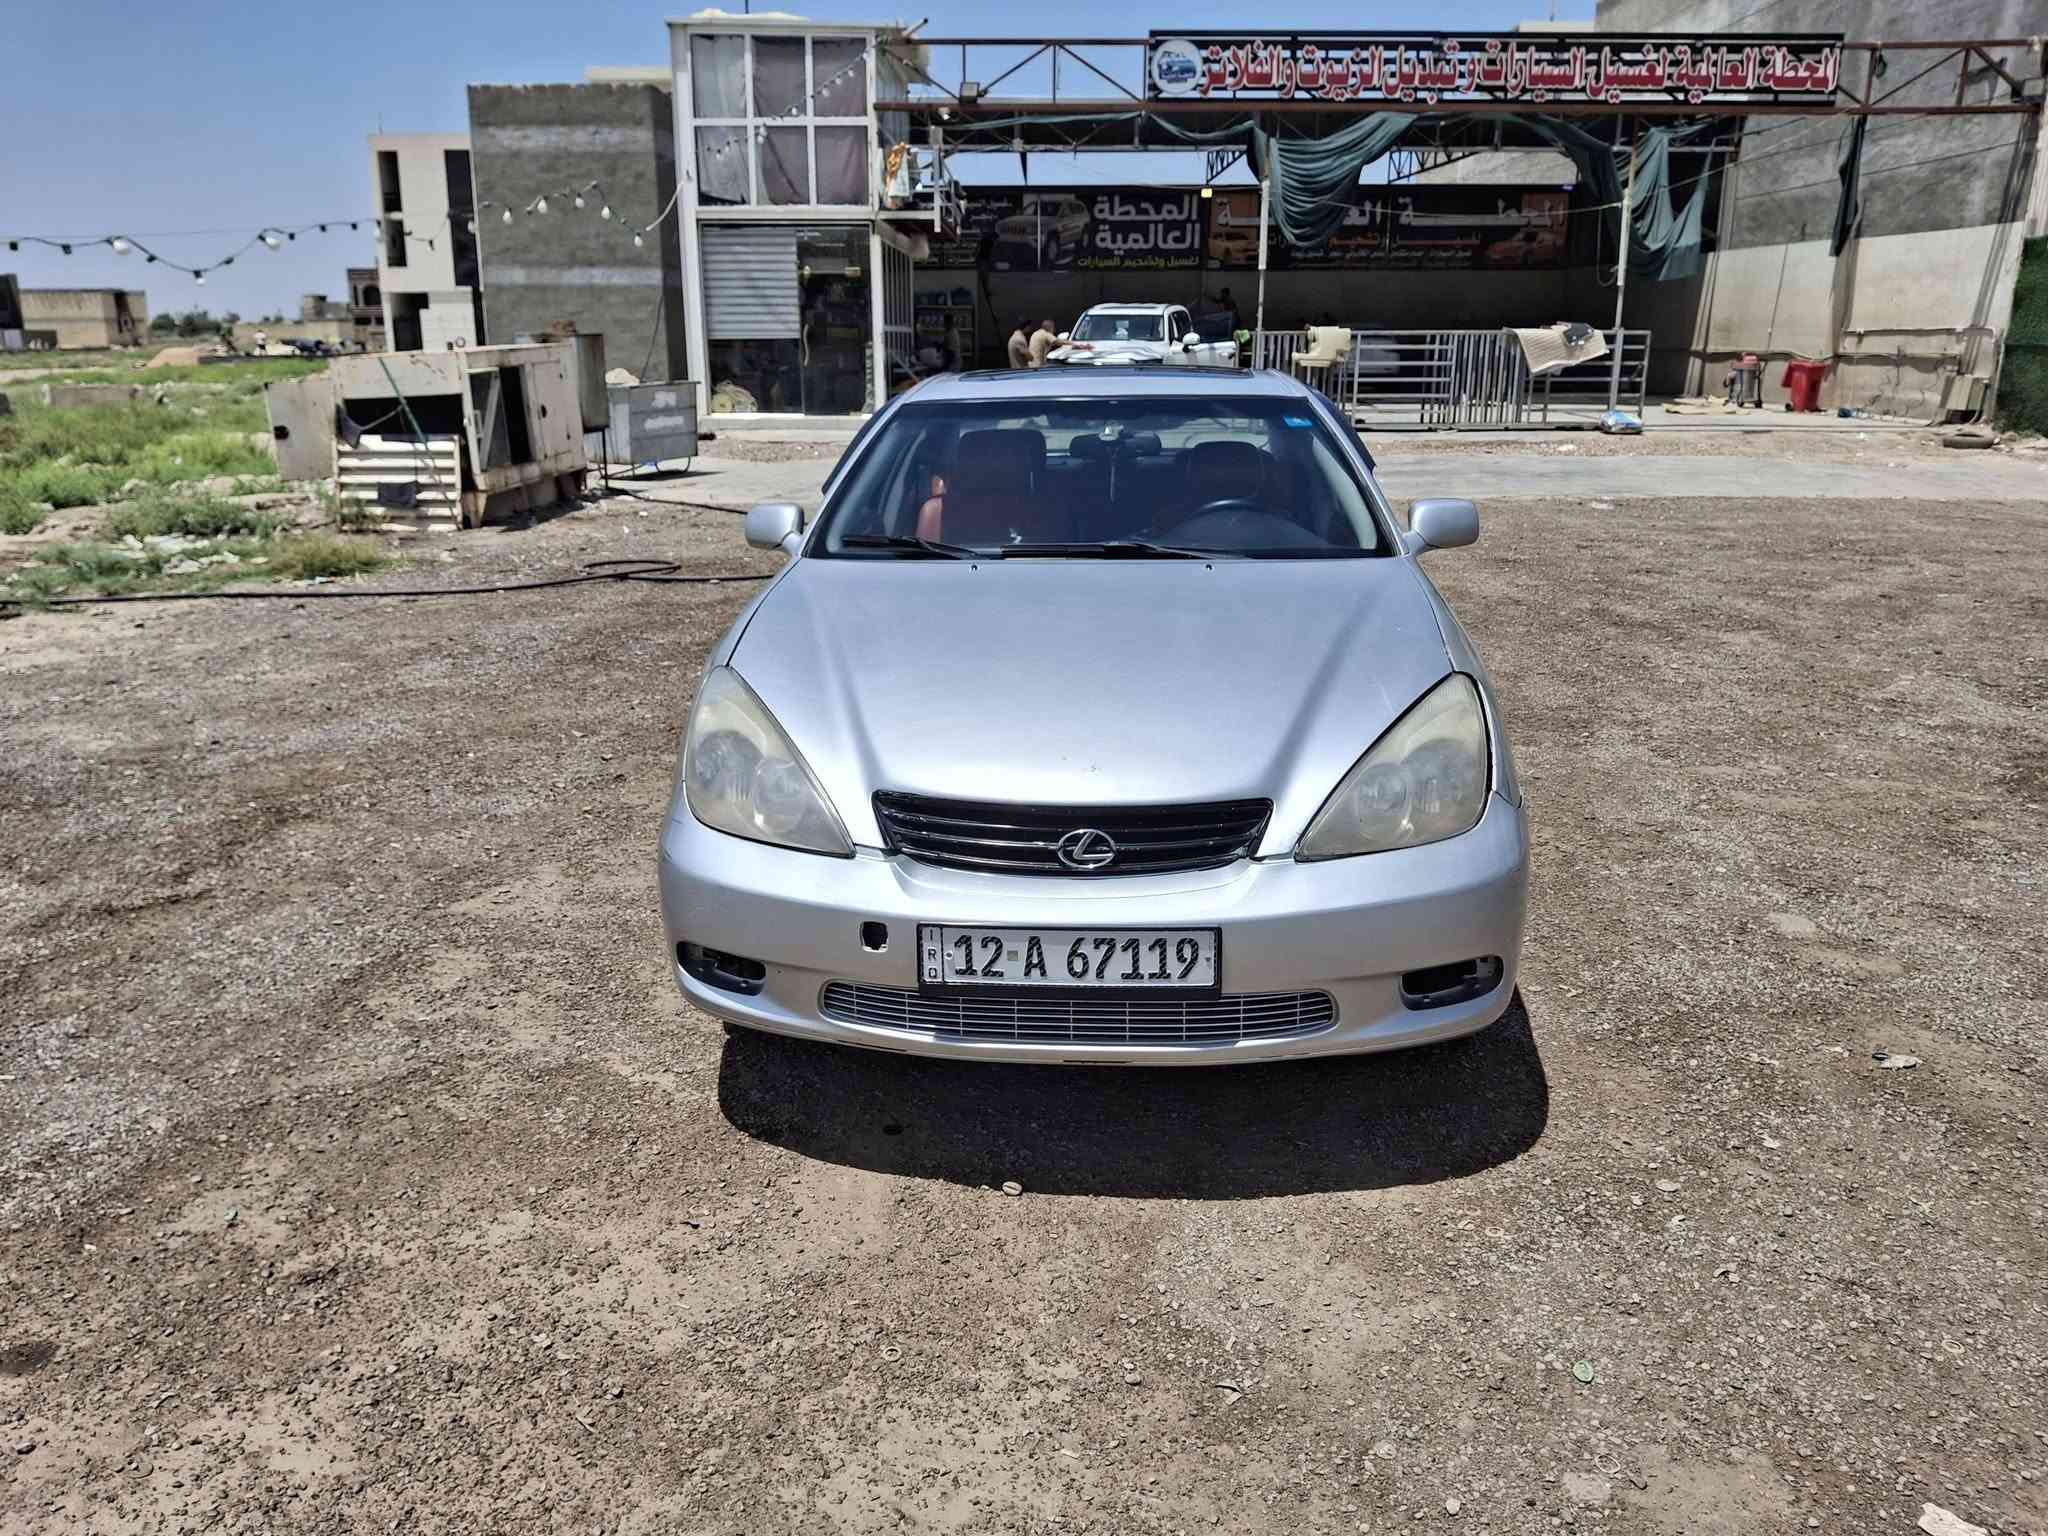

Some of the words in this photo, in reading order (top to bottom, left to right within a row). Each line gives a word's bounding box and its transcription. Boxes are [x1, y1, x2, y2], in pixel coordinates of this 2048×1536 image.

[1197, 39, 1296, 97] والفلاتر
[1298, 44, 1384, 102] الزيوت
[1381, 40, 1478, 104] وتبديل
[1480, 39, 1586, 103] السيارات
[1586, 44, 1670, 103] لغسيل
[1674, 44, 1760, 104] العالمية
[1760, 44, 1842, 93] المحطة
[1093, 194, 1198, 222] المحطة
[1095, 223, 1200, 255] العالمية
[954, 934, 1004, 977] 12
[1024, 935, 1048, 977] A
[1066, 936, 1200, 980] 67119
